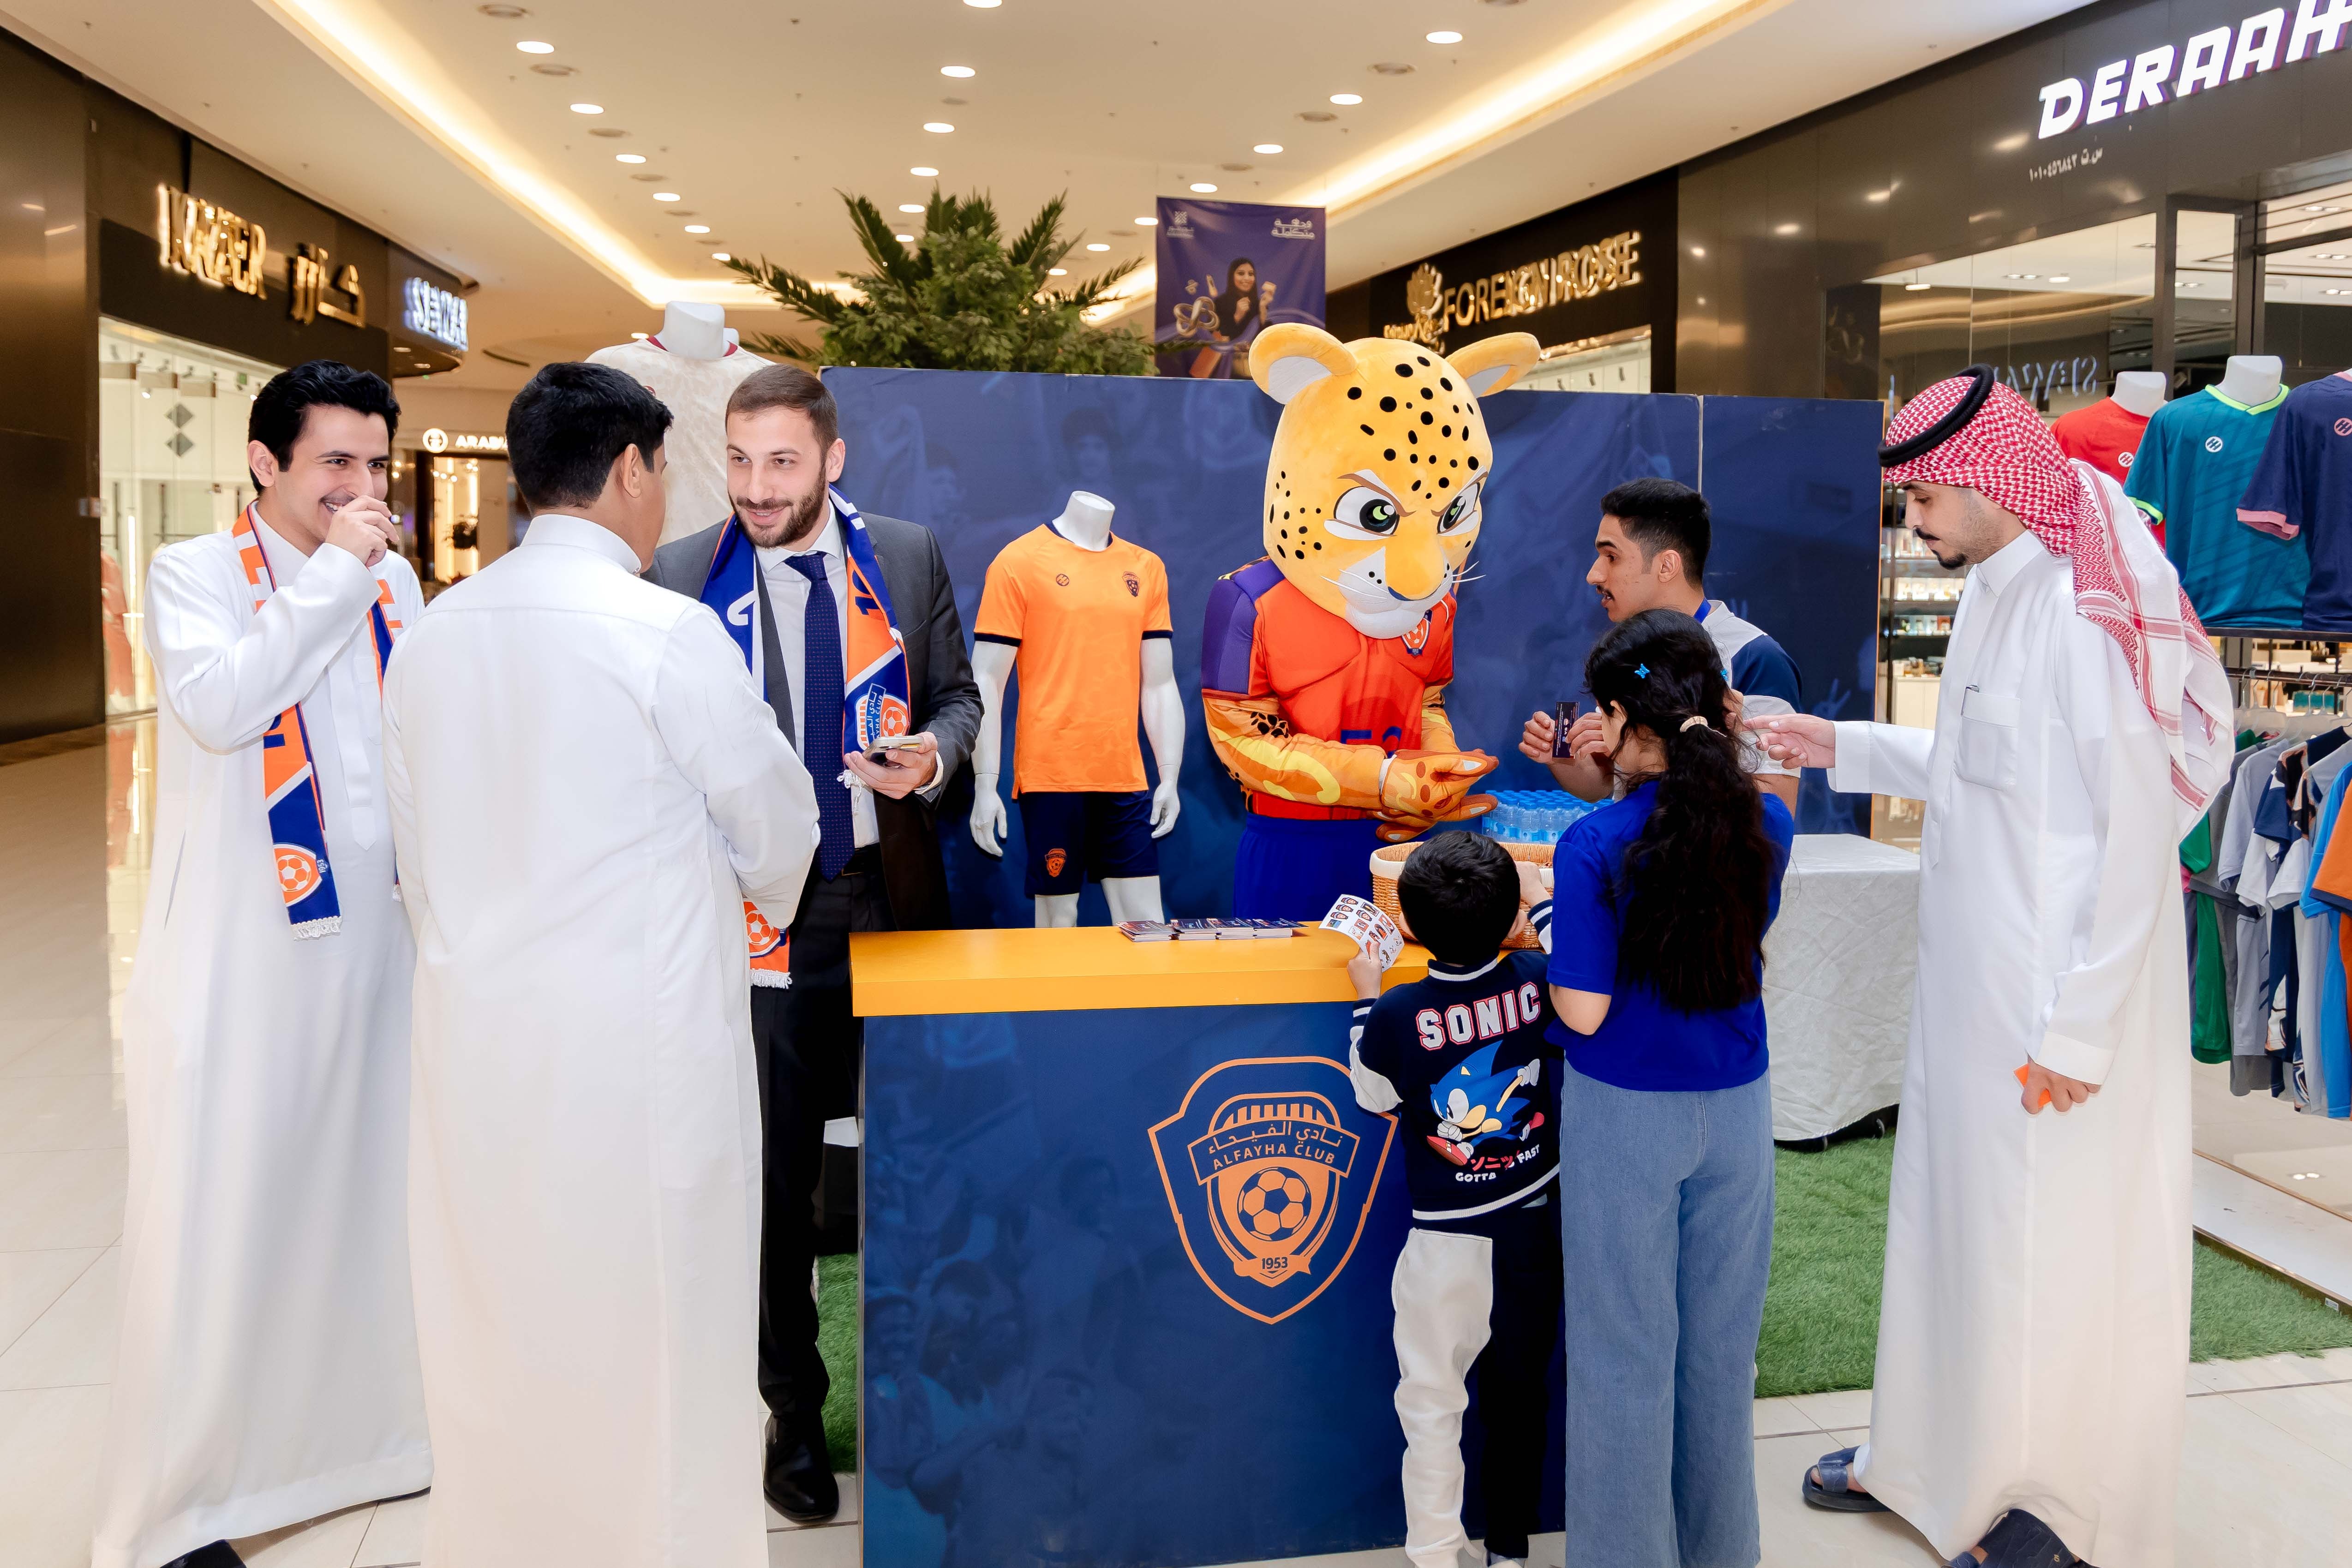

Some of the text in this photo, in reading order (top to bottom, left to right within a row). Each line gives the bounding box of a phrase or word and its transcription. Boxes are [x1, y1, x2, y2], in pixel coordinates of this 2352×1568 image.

[317, 859, 326, 873] 1953
[1416, 981, 1540, 1050] SONIC
[1209, 1121, 1342, 1154] نادي الفيحاء
[1213, 1143, 1335, 1170] ALFAYHA CLUB
[1455, 1144, 1540, 1182] GOTTA FAST
[1471, 1150, 1520, 1171] ソニッ
[1261, 1257, 1288, 1269] 1953
